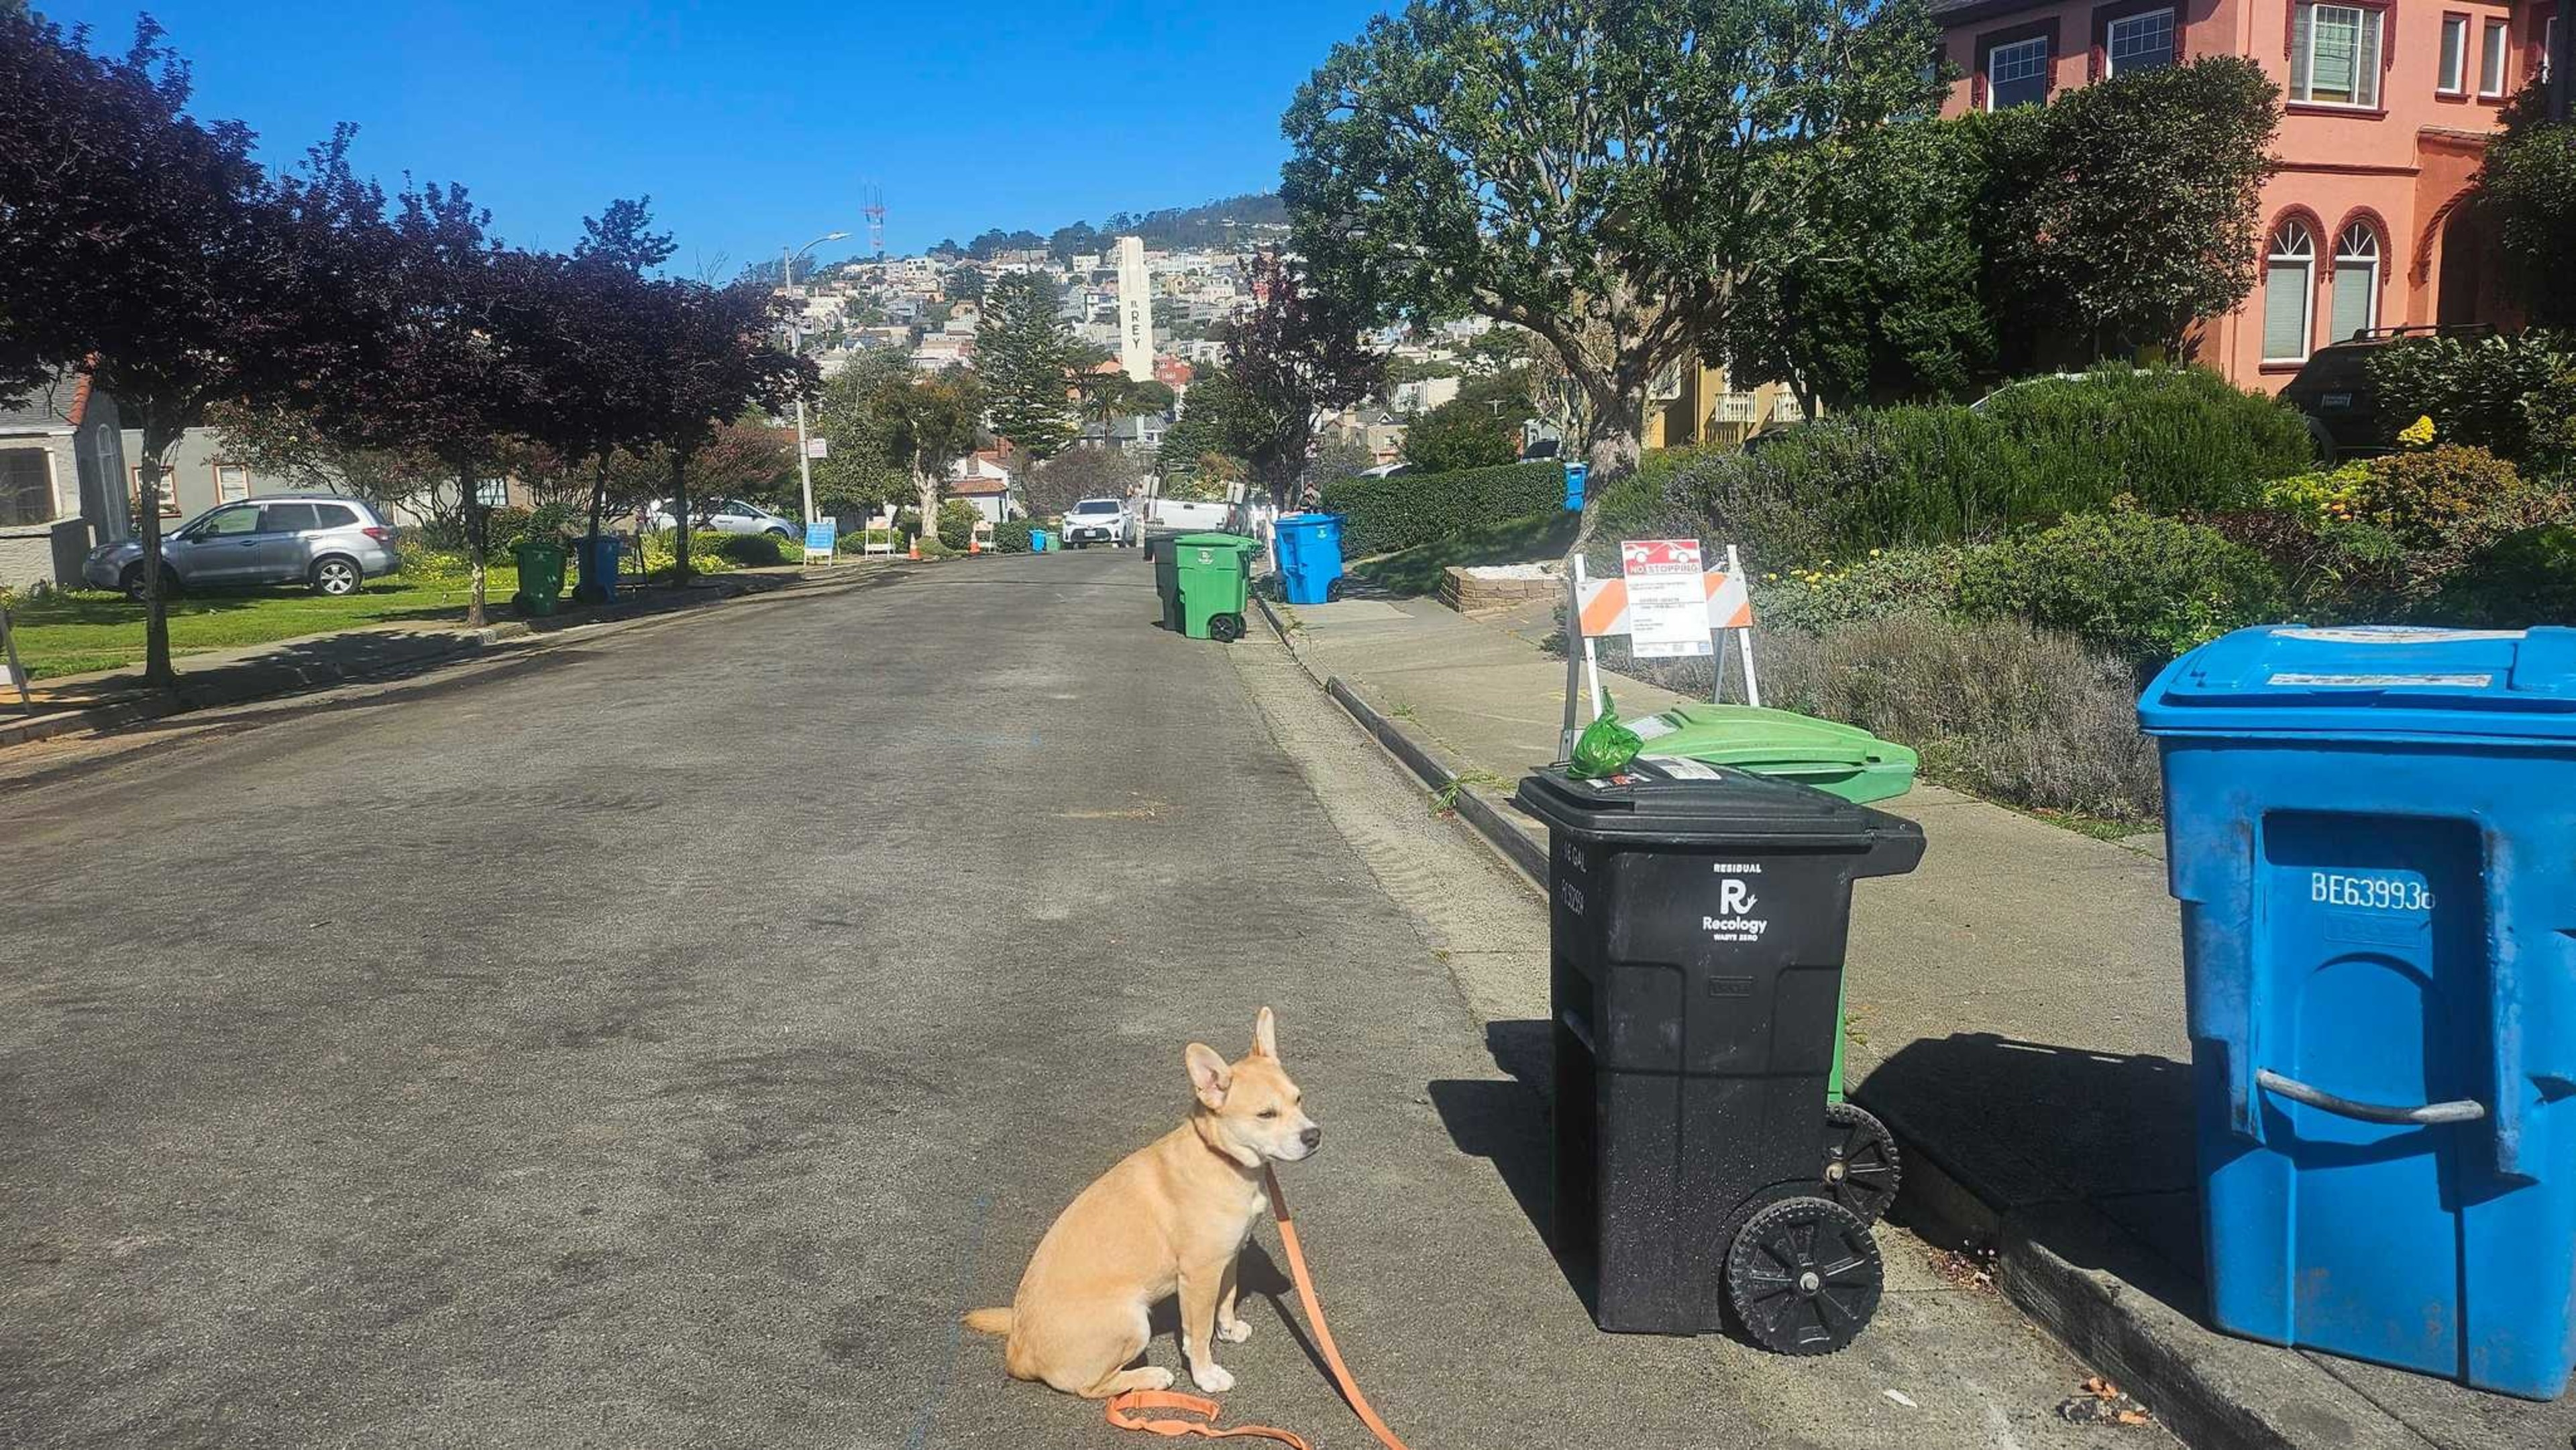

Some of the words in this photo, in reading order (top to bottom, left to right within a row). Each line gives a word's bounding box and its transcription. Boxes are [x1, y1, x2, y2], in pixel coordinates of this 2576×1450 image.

[1131, 311, 1140, 349] REY
[1630, 565, 1646, 574] NO
[1648, 564, 1698, 573] STOPPING
[1713, 863, 1762, 873] RESIDUAL
[1703, 915, 1768, 934] Recology
